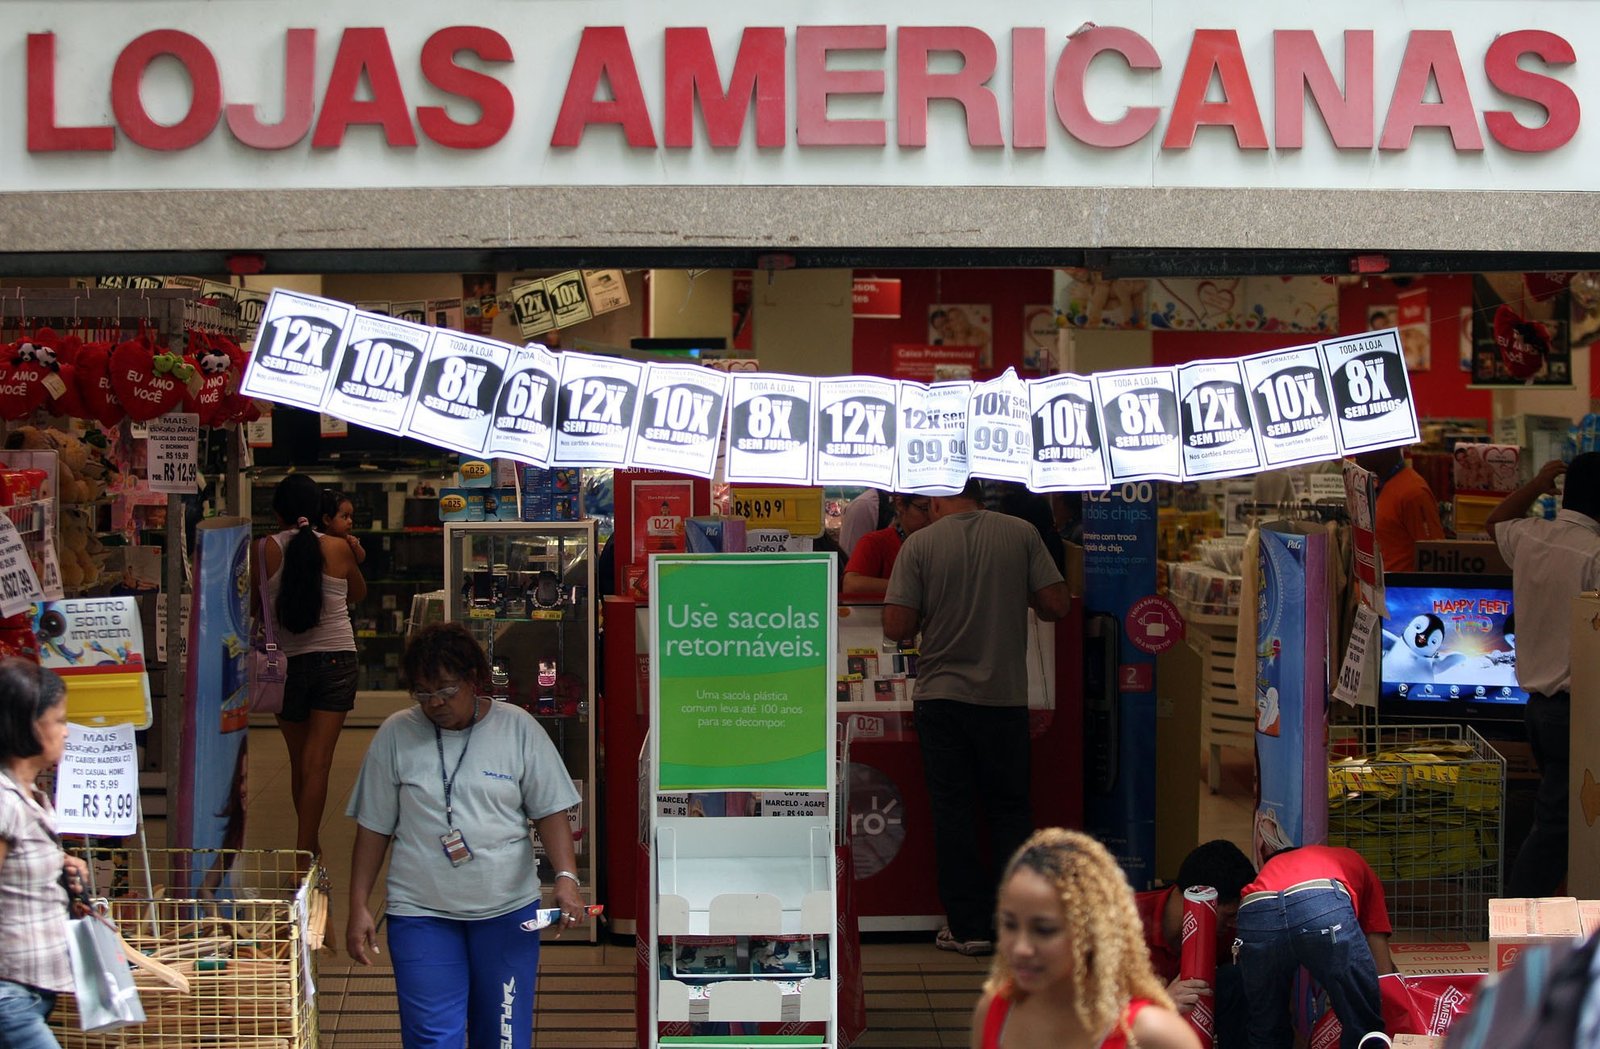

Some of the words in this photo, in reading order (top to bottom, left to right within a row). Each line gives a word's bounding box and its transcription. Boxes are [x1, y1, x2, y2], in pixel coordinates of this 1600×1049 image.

[27, 25, 514, 152] LOJAS
[550, 22, 1581, 152] AMERICANAS
[272, 316, 332, 366] 12X
[1339, 344, 1358, 355] TODA
[1359, 343, 1364, 352] A
[1365, 340, 1383, 350] LOJA
[450, 340, 469, 353] TODA
[475, 346, 494, 358] LOJA
[262, 355, 286, 370] SEM
[354, 339, 413, 392] 10X
[12, 371, 38, 382] AMO
[127, 370, 144, 382] EU
[148, 376, 175, 391] AMO
[207, 376, 224, 387] AMO
[438, 356, 486, 407] 8X
[1114, 379, 1132, 387] TODA
[1141, 377, 1158, 386] LOJA
[1345, 359, 1391, 404] 8X
[133, 386, 164, 404] VOCÊ
[342, 380, 367, 396] SEM
[750, 382, 768, 391] TODA
[777, 383, 795, 393] LOJA
[424, 395, 448, 412] SEM
[506, 372, 548, 422] 6X
[567, 380, 627, 424] 12X
[973, 392, 1011, 416] 10X
[1258, 374, 1322, 423] 10X
[652, 386, 714, 435] 10X
[1118, 393, 1165, 435] 8X
[1185, 386, 1242, 432] 12X
[1344, 405, 1368, 419] SEM
[1368, 399, 1402, 415] JUROS
[748, 396, 792, 438] 8X
[826, 401, 886, 444] 12X
[1038, 400, 1092, 447] 10X
[563, 420, 585, 432] SEM
[1267, 422, 1290, 436] SEM
[1291, 416, 1325, 432] JUROS
[645, 427, 670, 441] SEM
[1116, 435, 1140, 448] SEM
[1189, 431, 1214, 446] SEM
[738, 438, 763, 450] SEM
[826, 443, 853, 455] SEM
[1038, 447, 1061, 460] SEM
[1118, 533, 1137, 541] troca
[1287, 539, 1301, 549] P&G
[1418, 550, 1485, 573] Philco
[1434, 599, 1475, 614] HAPPY
[1478, 599, 1511, 615] FEET
[76, 616, 105, 627] SOM
[668, 604, 718, 628] Use
[729, 605, 819, 629] sacolas
[71, 629, 131, 640] IMAGEM
[666, 633, 820, 657] retornáveis.
[1127, 668, 1137, 683] 2
[696, 690, 719, 700] Uma
[723, 690, 750, 700] sacola
[754, 690, 788, 703] plástica
[682, 705, 717, 713] comum
[720, 703, 738, 713] leva
[741, 703, 756, 713] até
[761, 704, 778, 713] 100
[698, 718, 719, 728] para
[722, 718, 732, 726] se
[735, 717, 786, 729] decompor.
[83, 733, 117, 742] MAIS
[65, 742, 100, 754] Barato
[103, 742, 133, 752] Ainda
[75, 755, 96, 763] CABIDE
[97, 755, 122, 764] MADEIRA
[85, 768, 107, 776] CASUAL
[100, 780, 119, 790] 5,99
[657, 796, 690, 804] MARCELO
[82, 794, 100, 818] R$
[104, 793, 133, 823] 3,99
